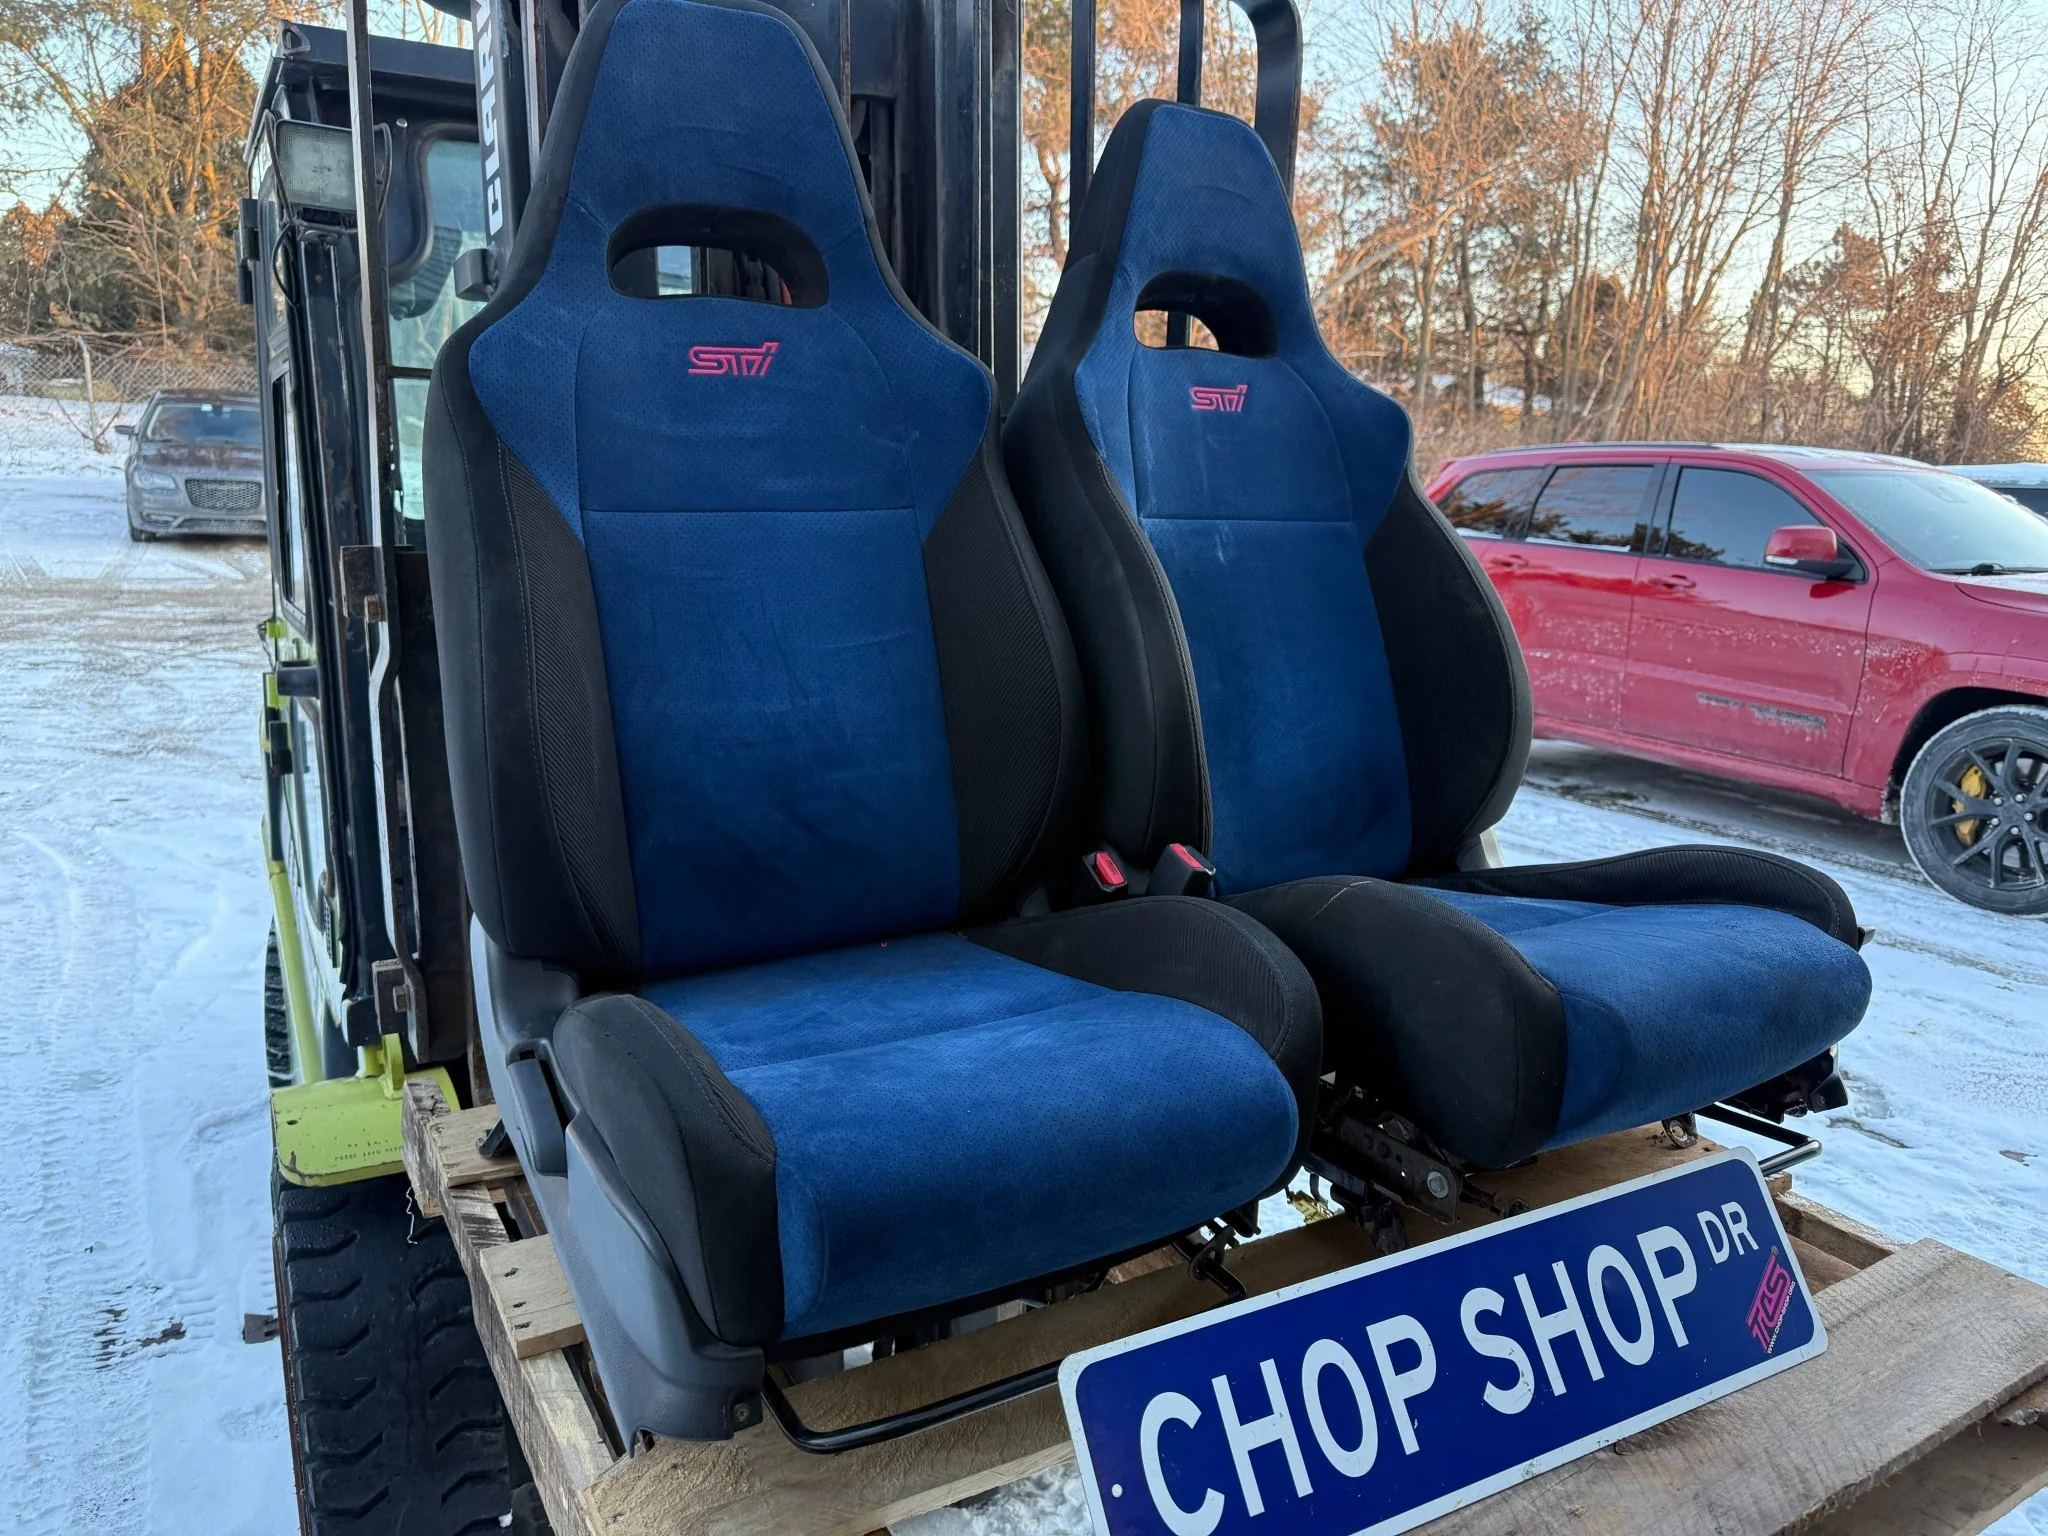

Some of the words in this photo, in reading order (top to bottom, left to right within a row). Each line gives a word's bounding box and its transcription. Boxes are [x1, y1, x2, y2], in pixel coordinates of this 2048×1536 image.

[1140, 1314, 1437, 1536] CHOP
[1460, 1225, 1698, 1414] SHOP
[1697, 1201, 1760, 1264] DR
